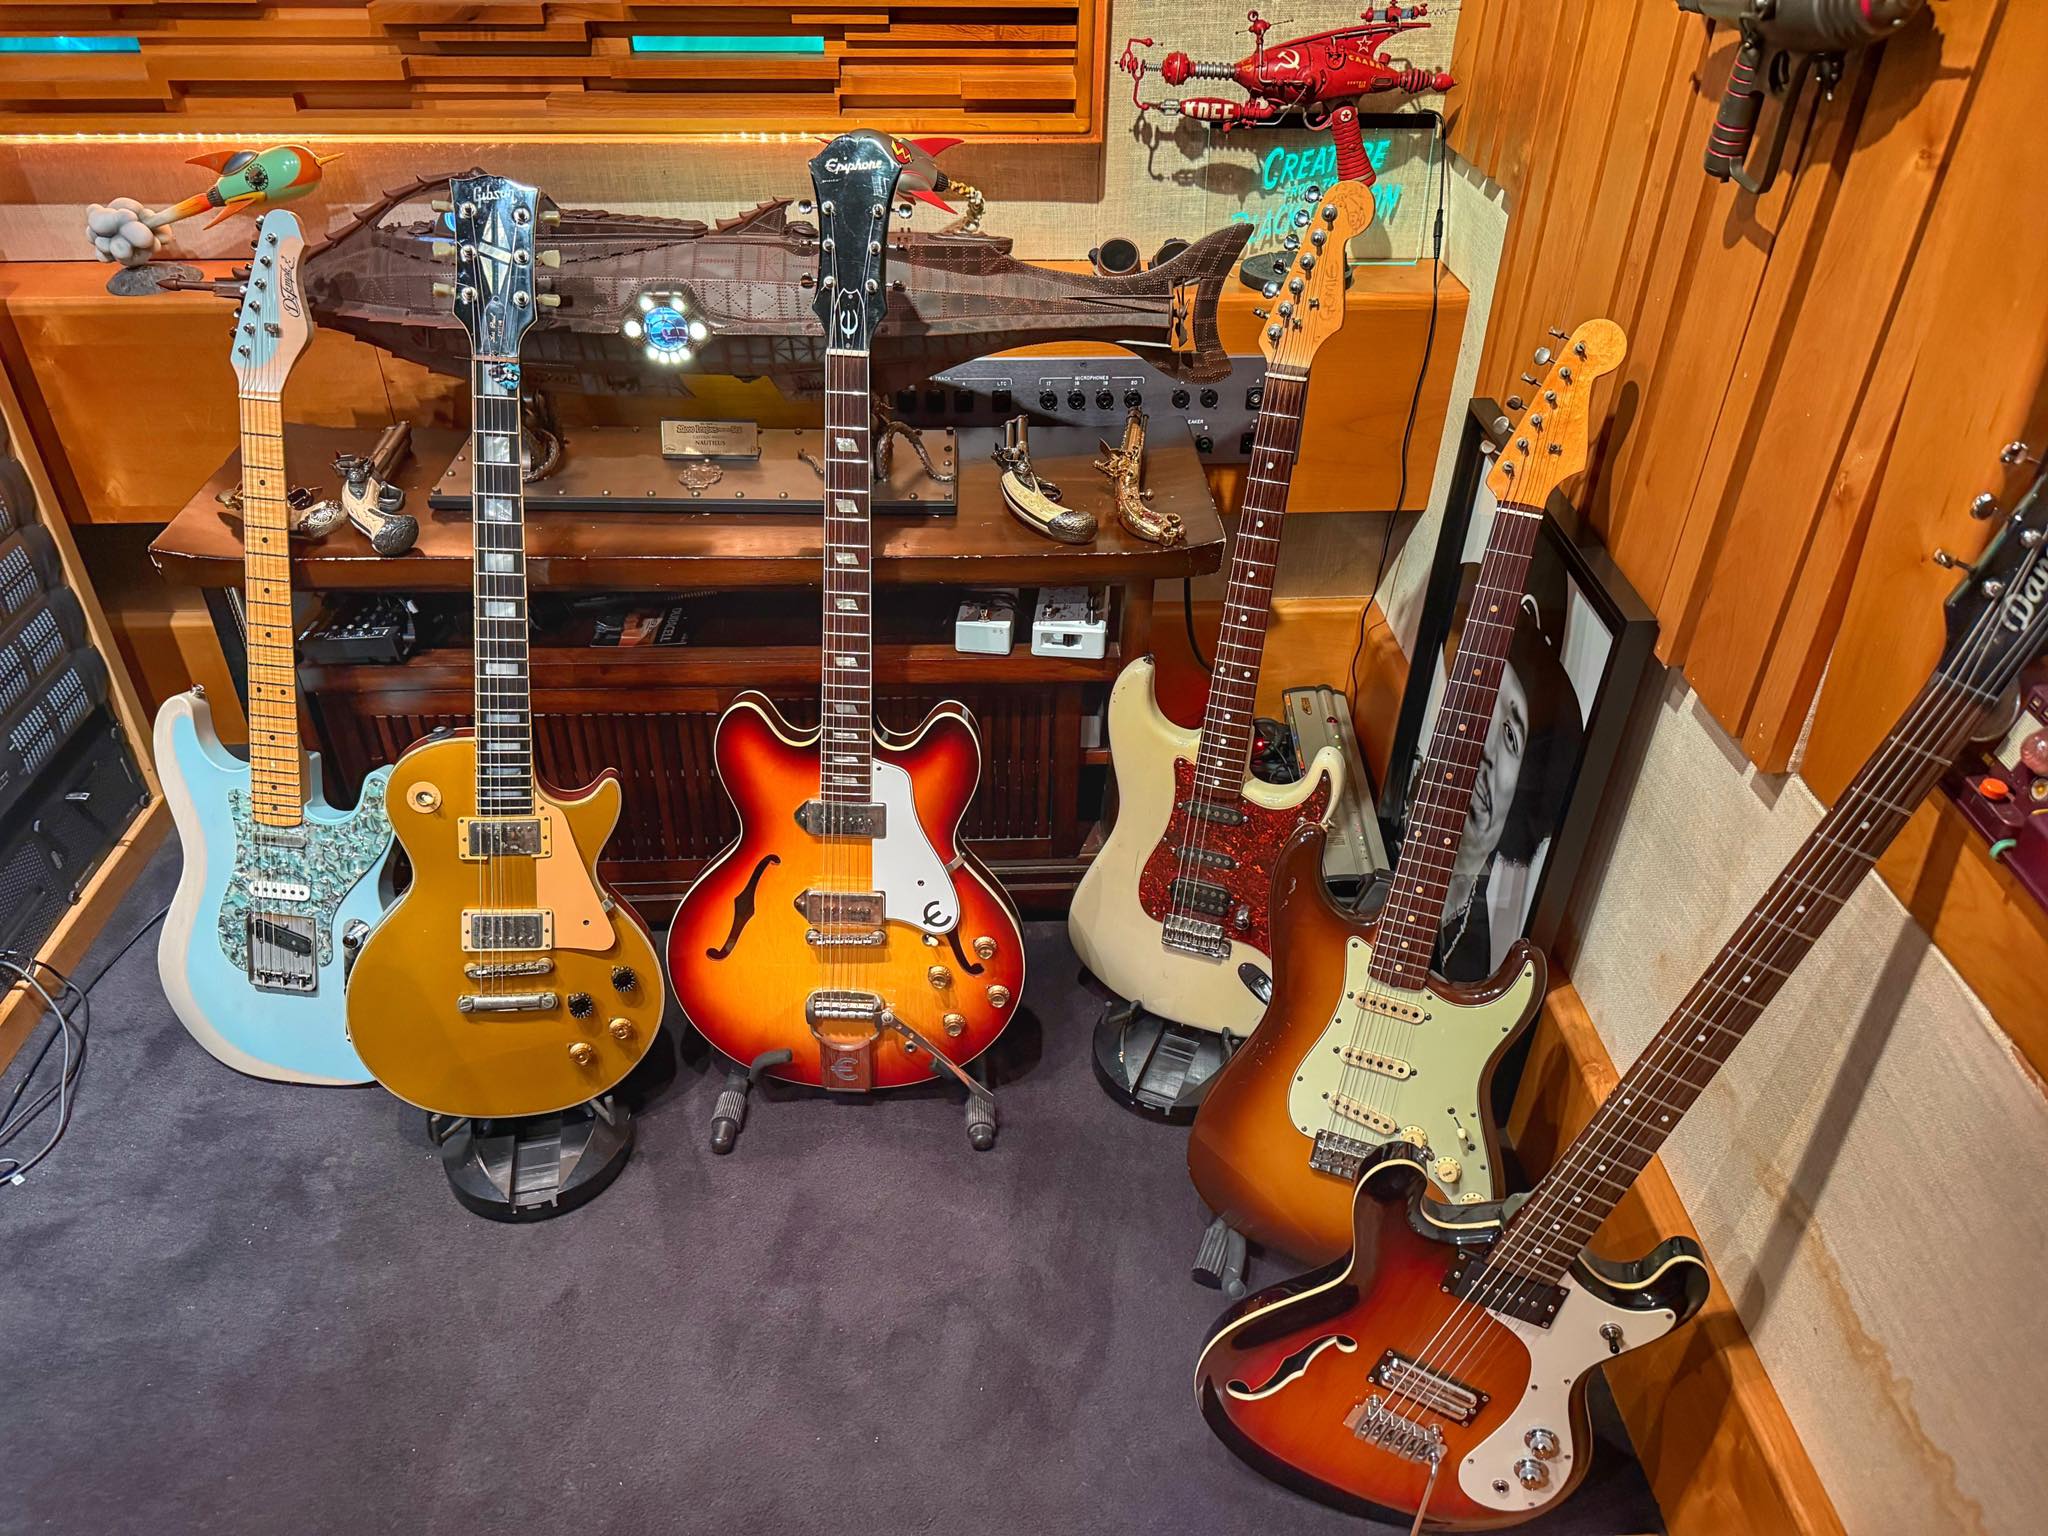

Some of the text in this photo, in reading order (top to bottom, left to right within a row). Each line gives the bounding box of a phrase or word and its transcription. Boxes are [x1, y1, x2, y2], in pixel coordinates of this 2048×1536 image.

[824, 157, 883, 175] Epiphone
[1262, 139, 1392, 190] CREATRE
[473, 185, 518, 208] Gibson
[2001, 547, 2048, 632] Dan
